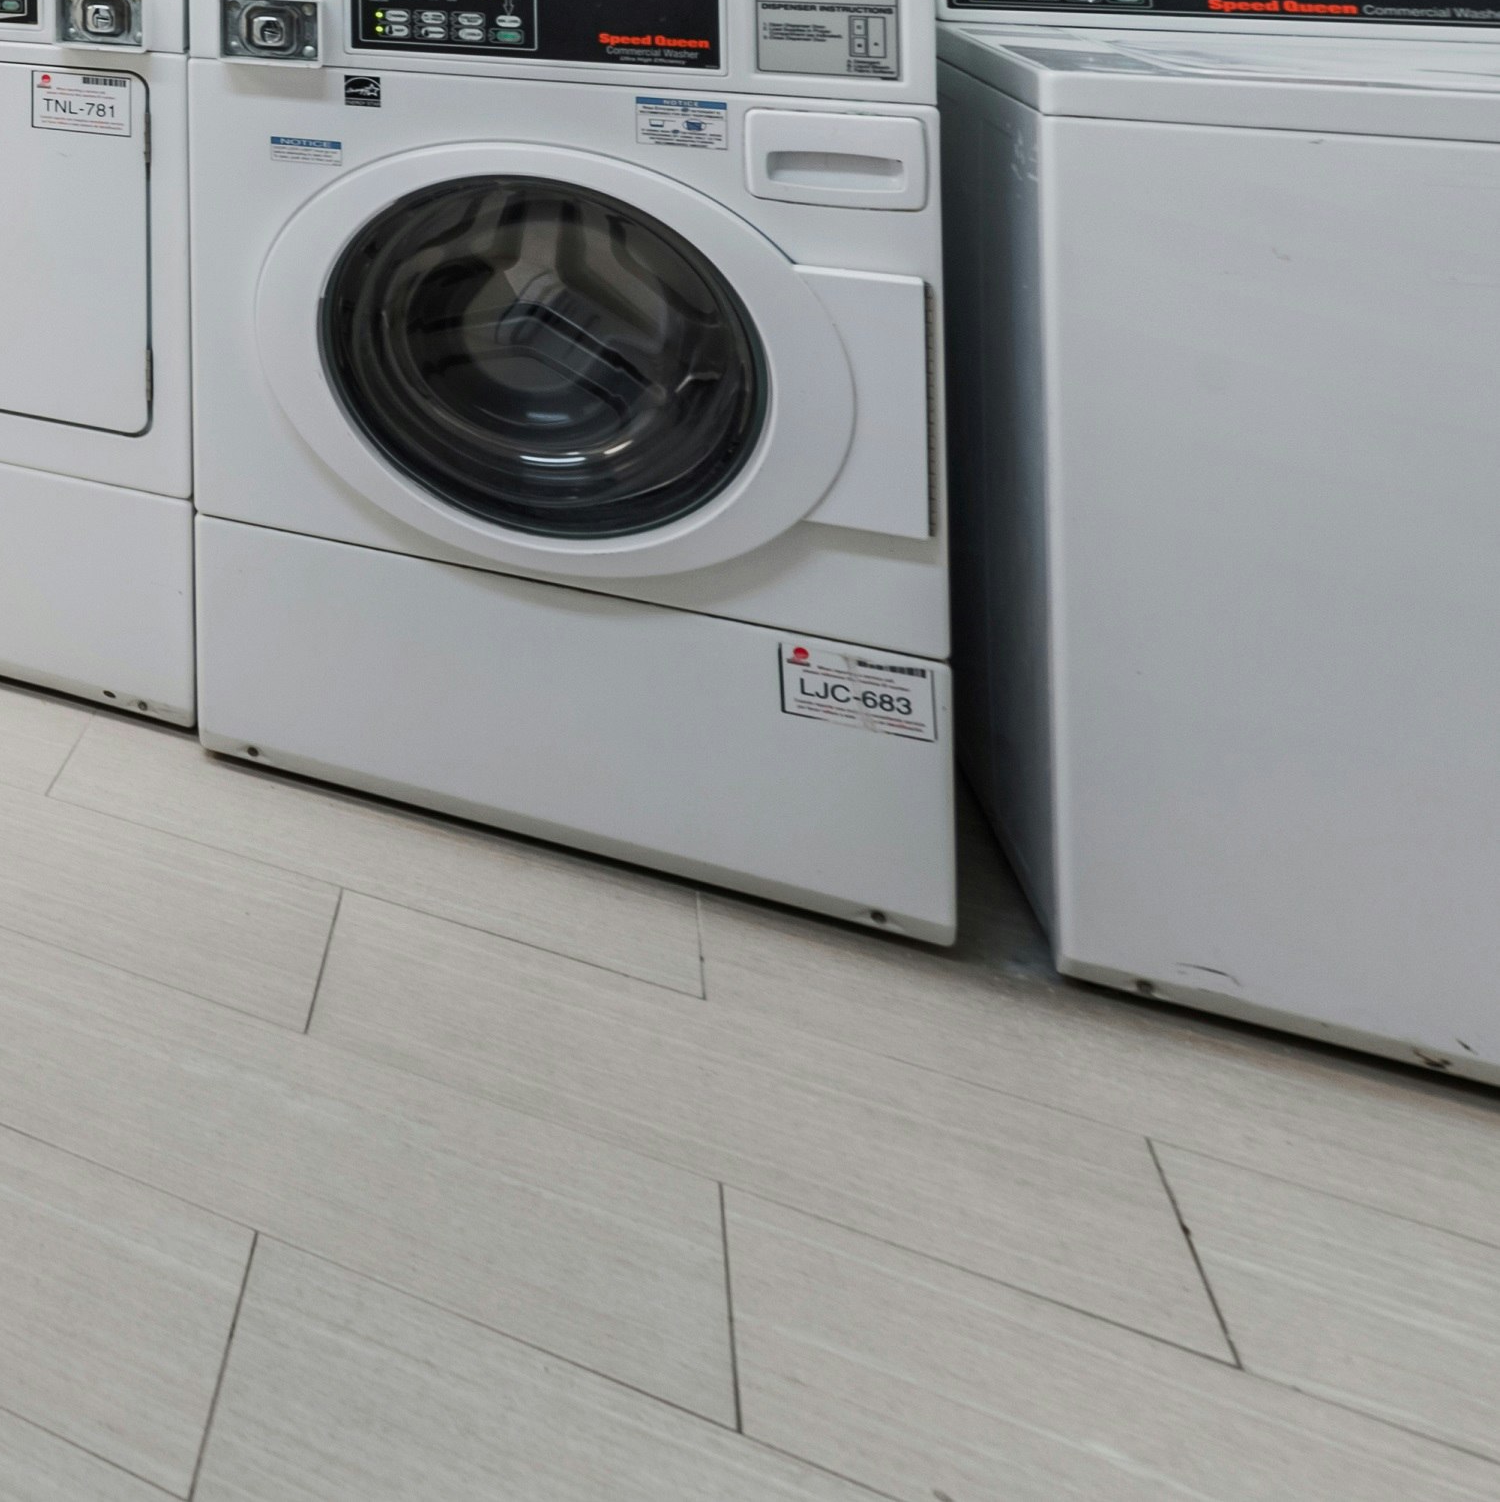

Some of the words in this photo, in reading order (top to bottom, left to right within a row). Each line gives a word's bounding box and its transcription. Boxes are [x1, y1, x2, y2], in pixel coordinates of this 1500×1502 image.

[761, 2, 817, 12] DISPENSER
[819, 5, 894, 15] INSTRUCTIONS
[1282, 0, 1359, 16] Queen
[1362, 4, 1451, 17] Commercial
[599, 33, 652, 46] Speed
[655, 35, 710, 49] Queen
[606, 45, 661, 57] Commercial
[663, 49, 699, 59] Washer
[42, 97, 115, 118] TNL-781
[280, 138, 329, 148] NOTICE
[799, 676, 913, 716] LJC-683
